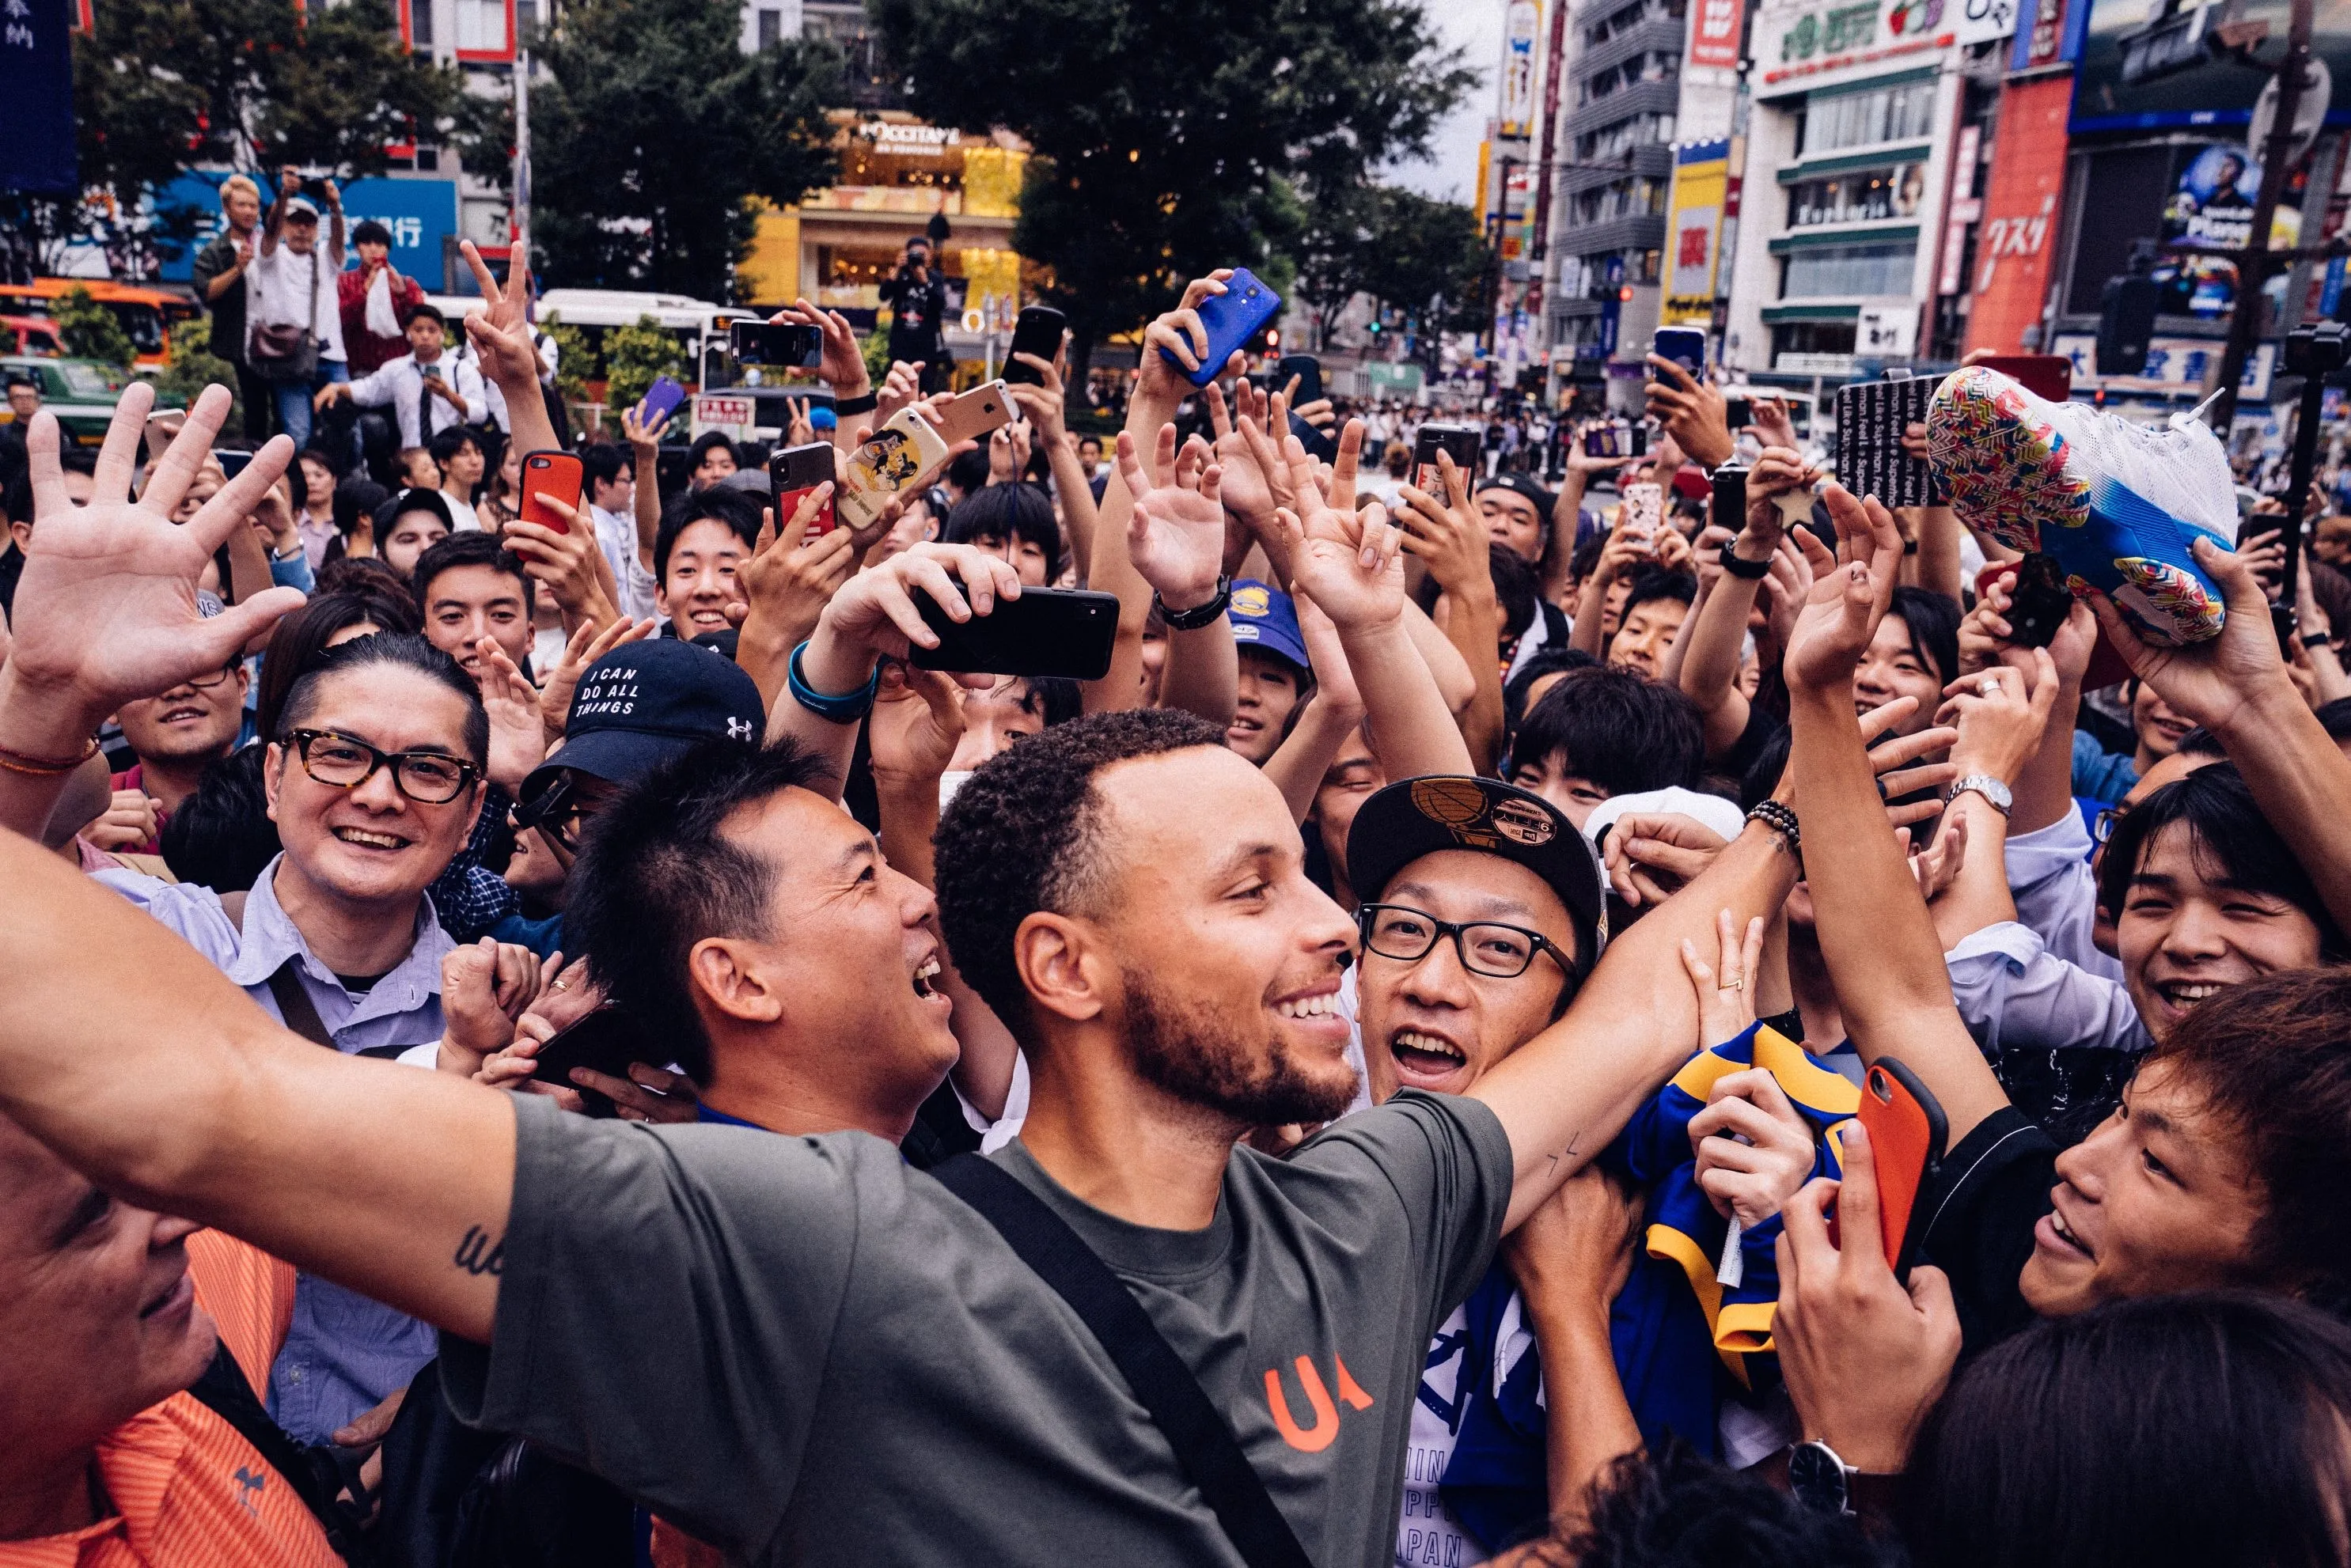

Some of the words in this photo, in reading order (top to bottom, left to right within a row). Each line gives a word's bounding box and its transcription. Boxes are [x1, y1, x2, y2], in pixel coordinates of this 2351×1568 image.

[590, 671, 598, 682] I
[600, 668, 637, 680] CAN
[581, 685, 601, 700] DO
[607, 684, 639, 698] ALL
[576, 701, 634, 718] THINGS
[1500, 812, 1550, 832] 9FIFTY
